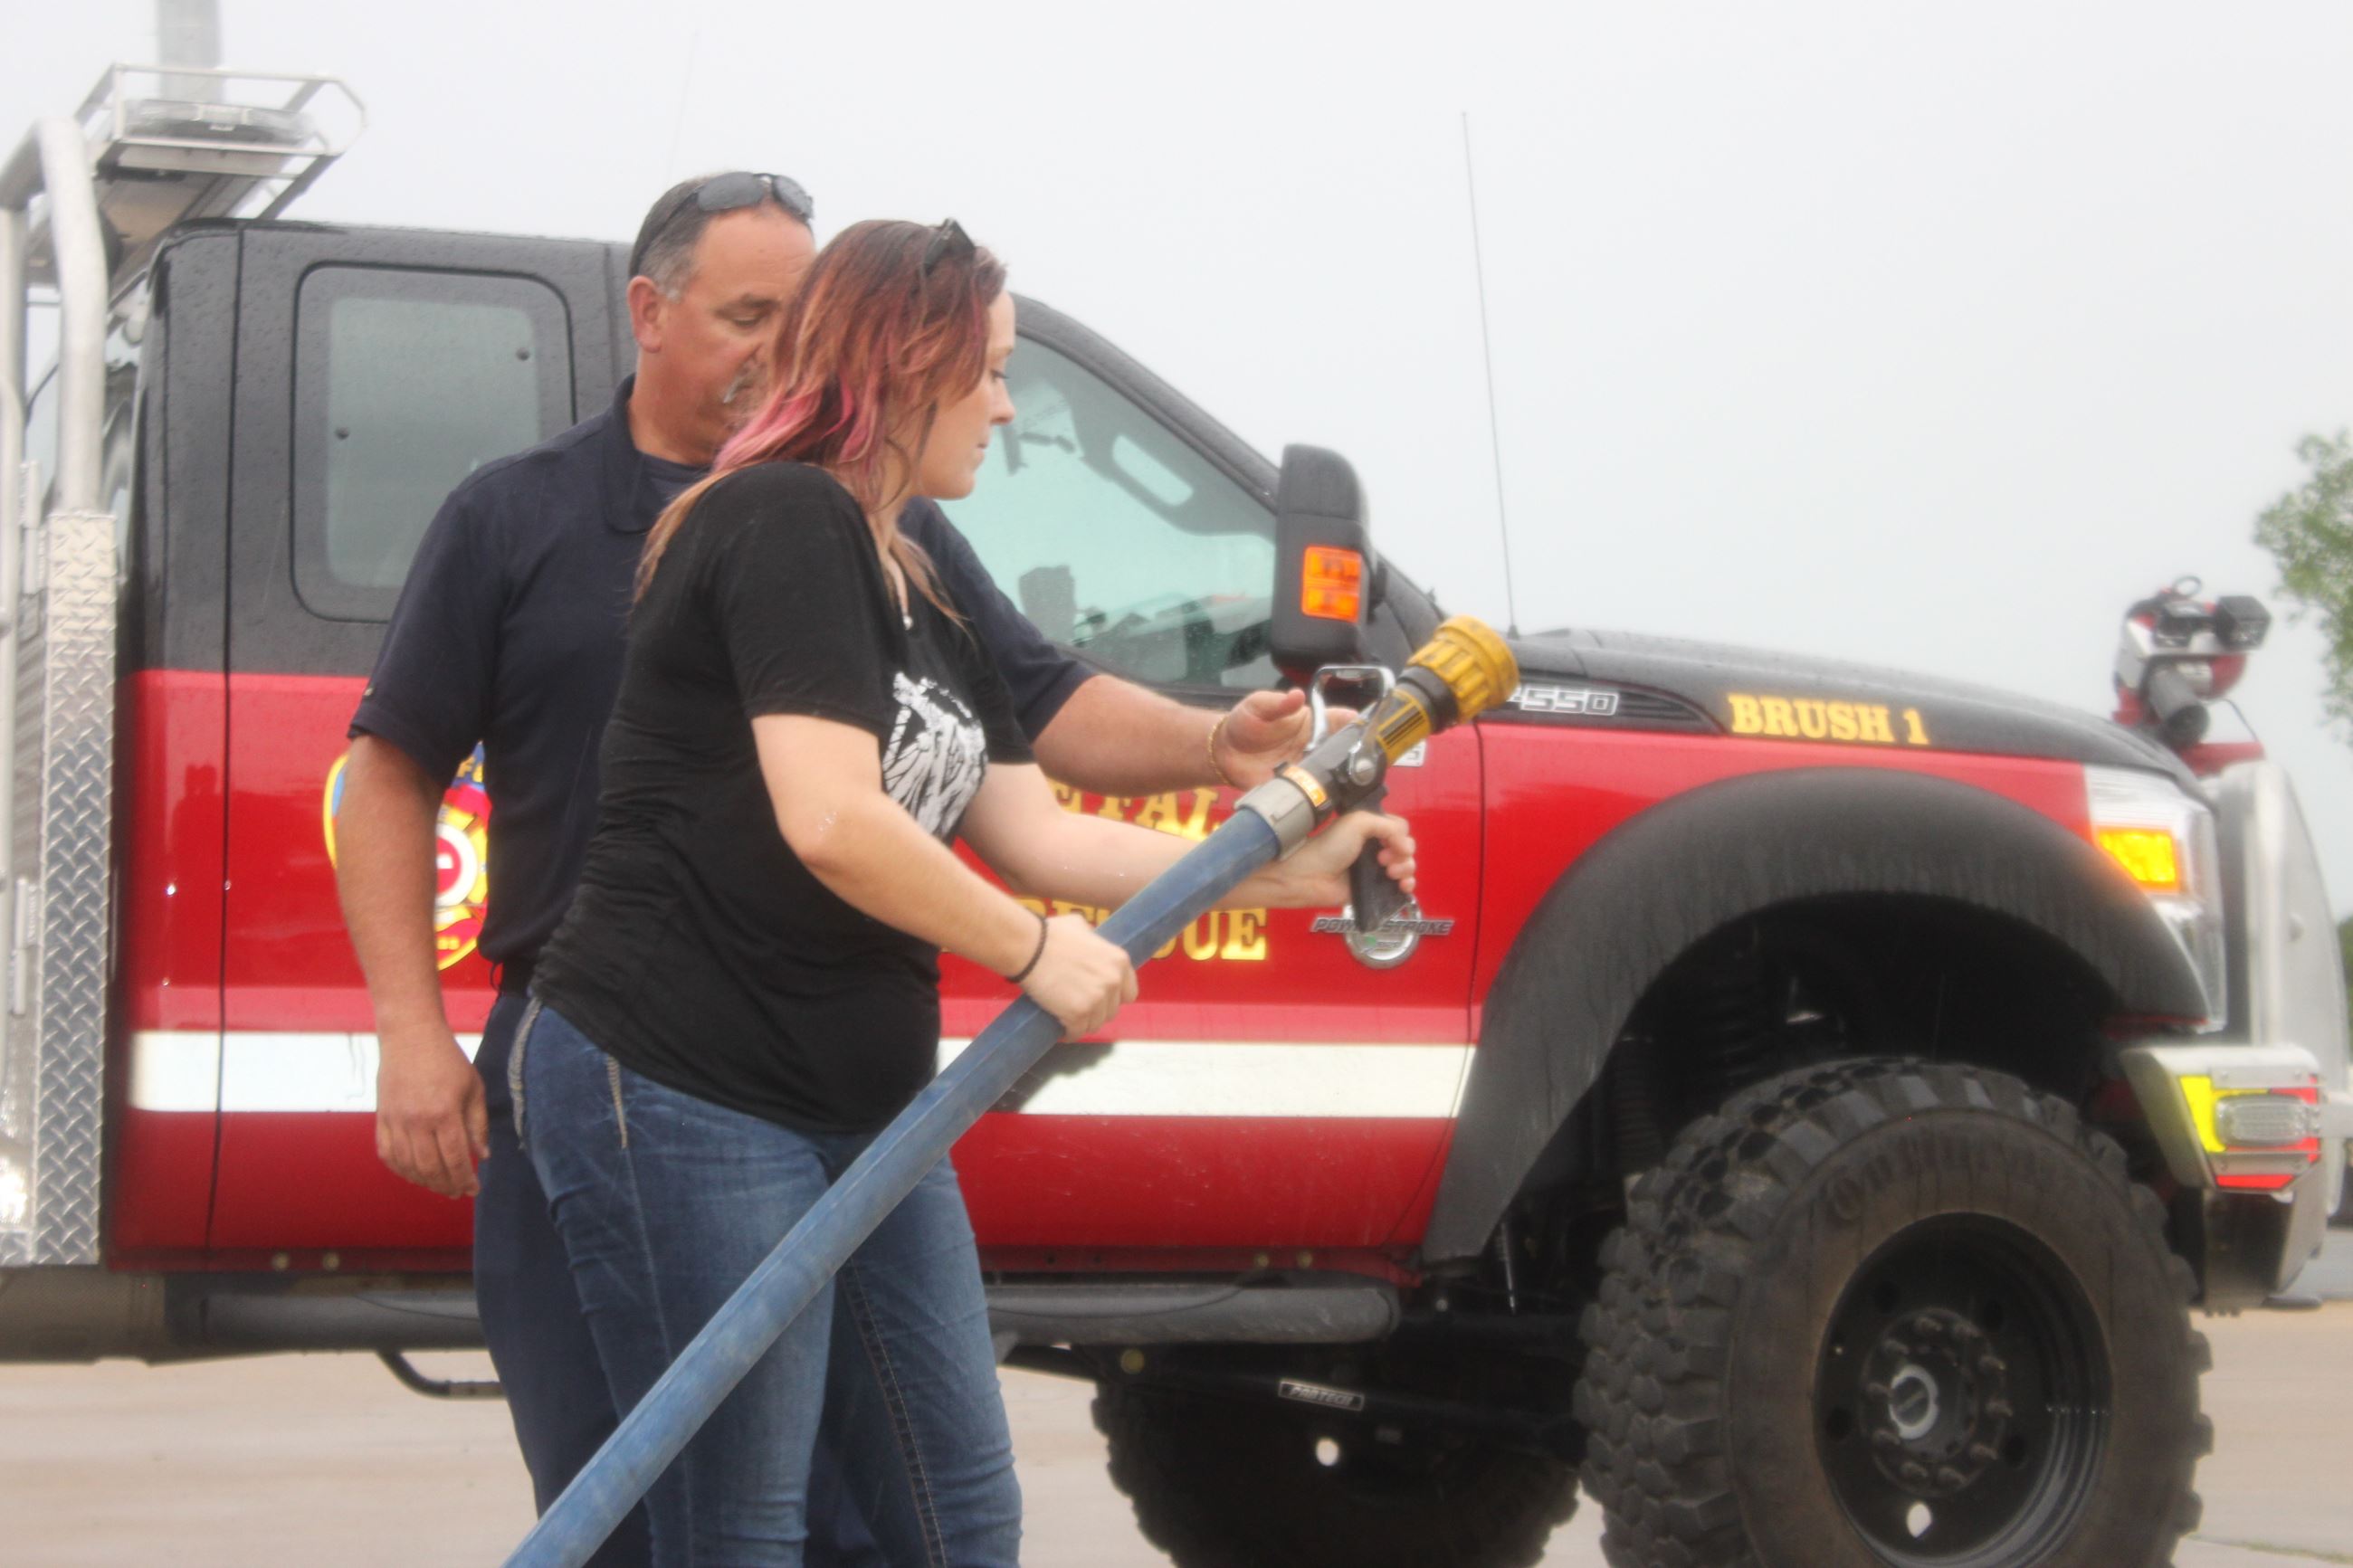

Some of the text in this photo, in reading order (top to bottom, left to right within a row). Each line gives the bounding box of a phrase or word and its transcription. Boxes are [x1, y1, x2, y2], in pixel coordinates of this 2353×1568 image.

[1728, 693, 1929, 745] BRUSH 1
[1379, 919, 1455, 936] STROKE
